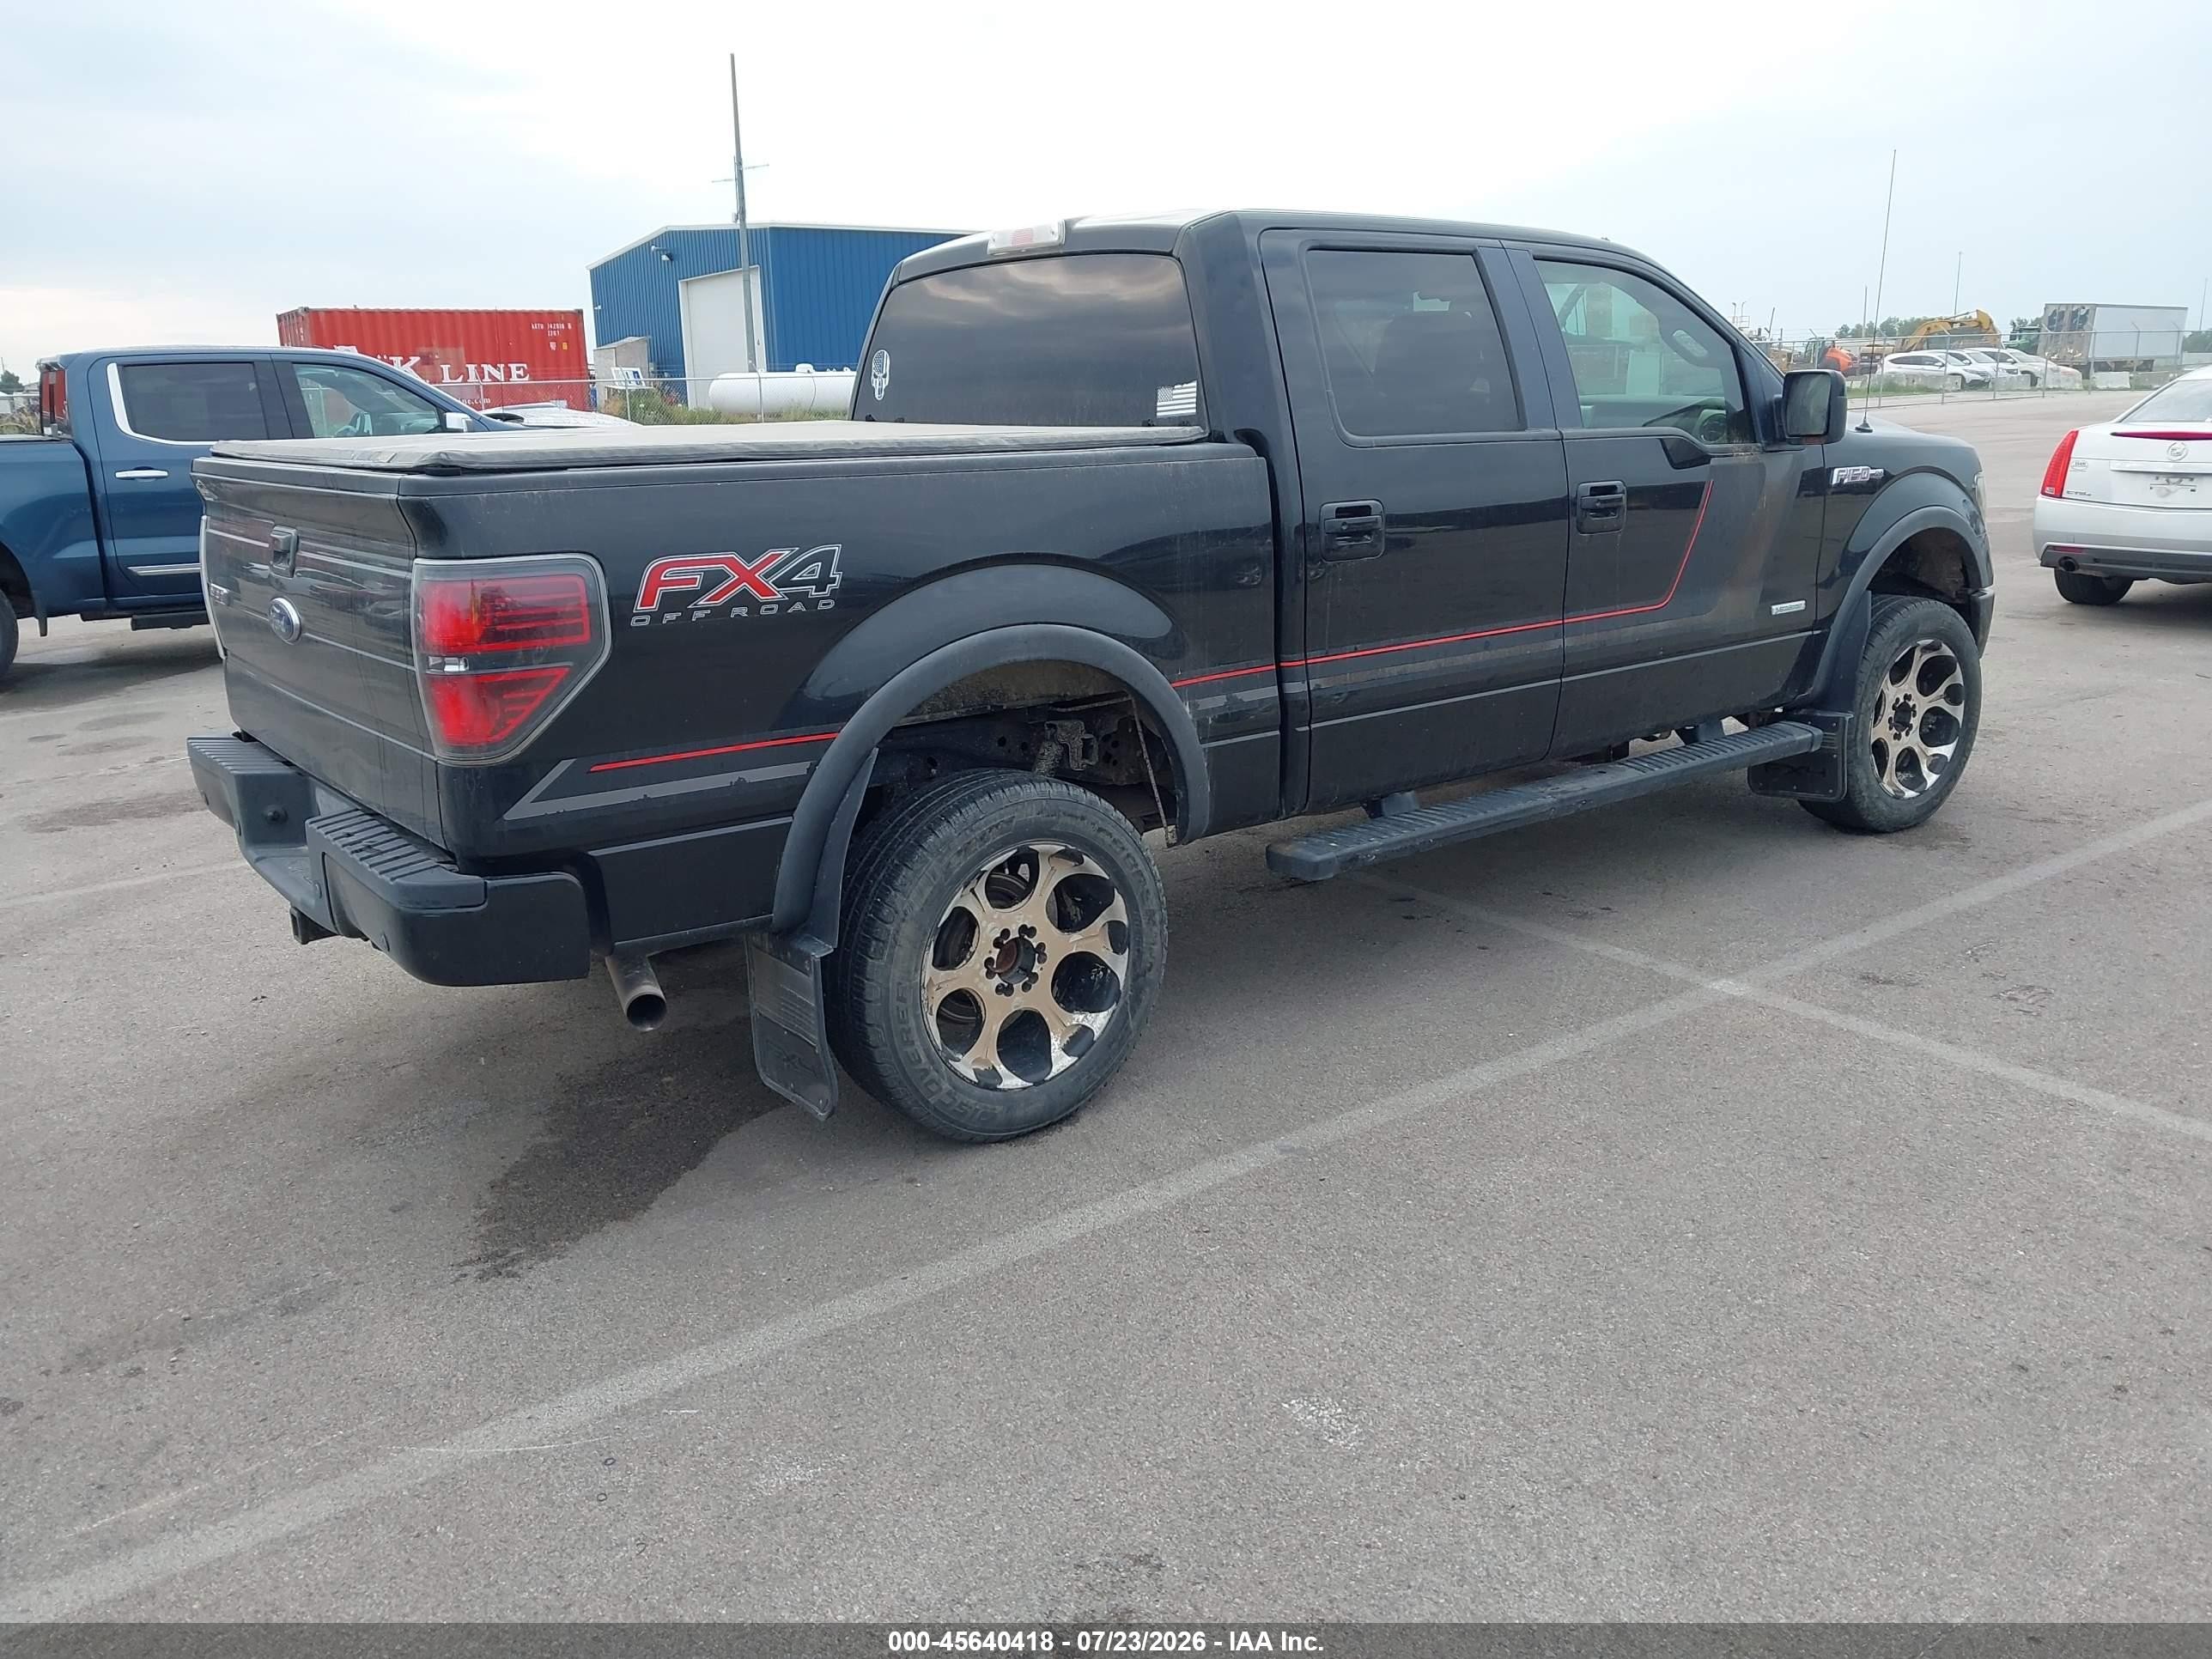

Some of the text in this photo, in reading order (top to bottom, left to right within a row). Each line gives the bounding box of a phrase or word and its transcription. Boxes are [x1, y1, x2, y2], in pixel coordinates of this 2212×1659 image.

[441, 363, 530, 383] LINE
[633, 544, 842, 612] FX4
[630, 599, 836, 627] OFF ROAD
